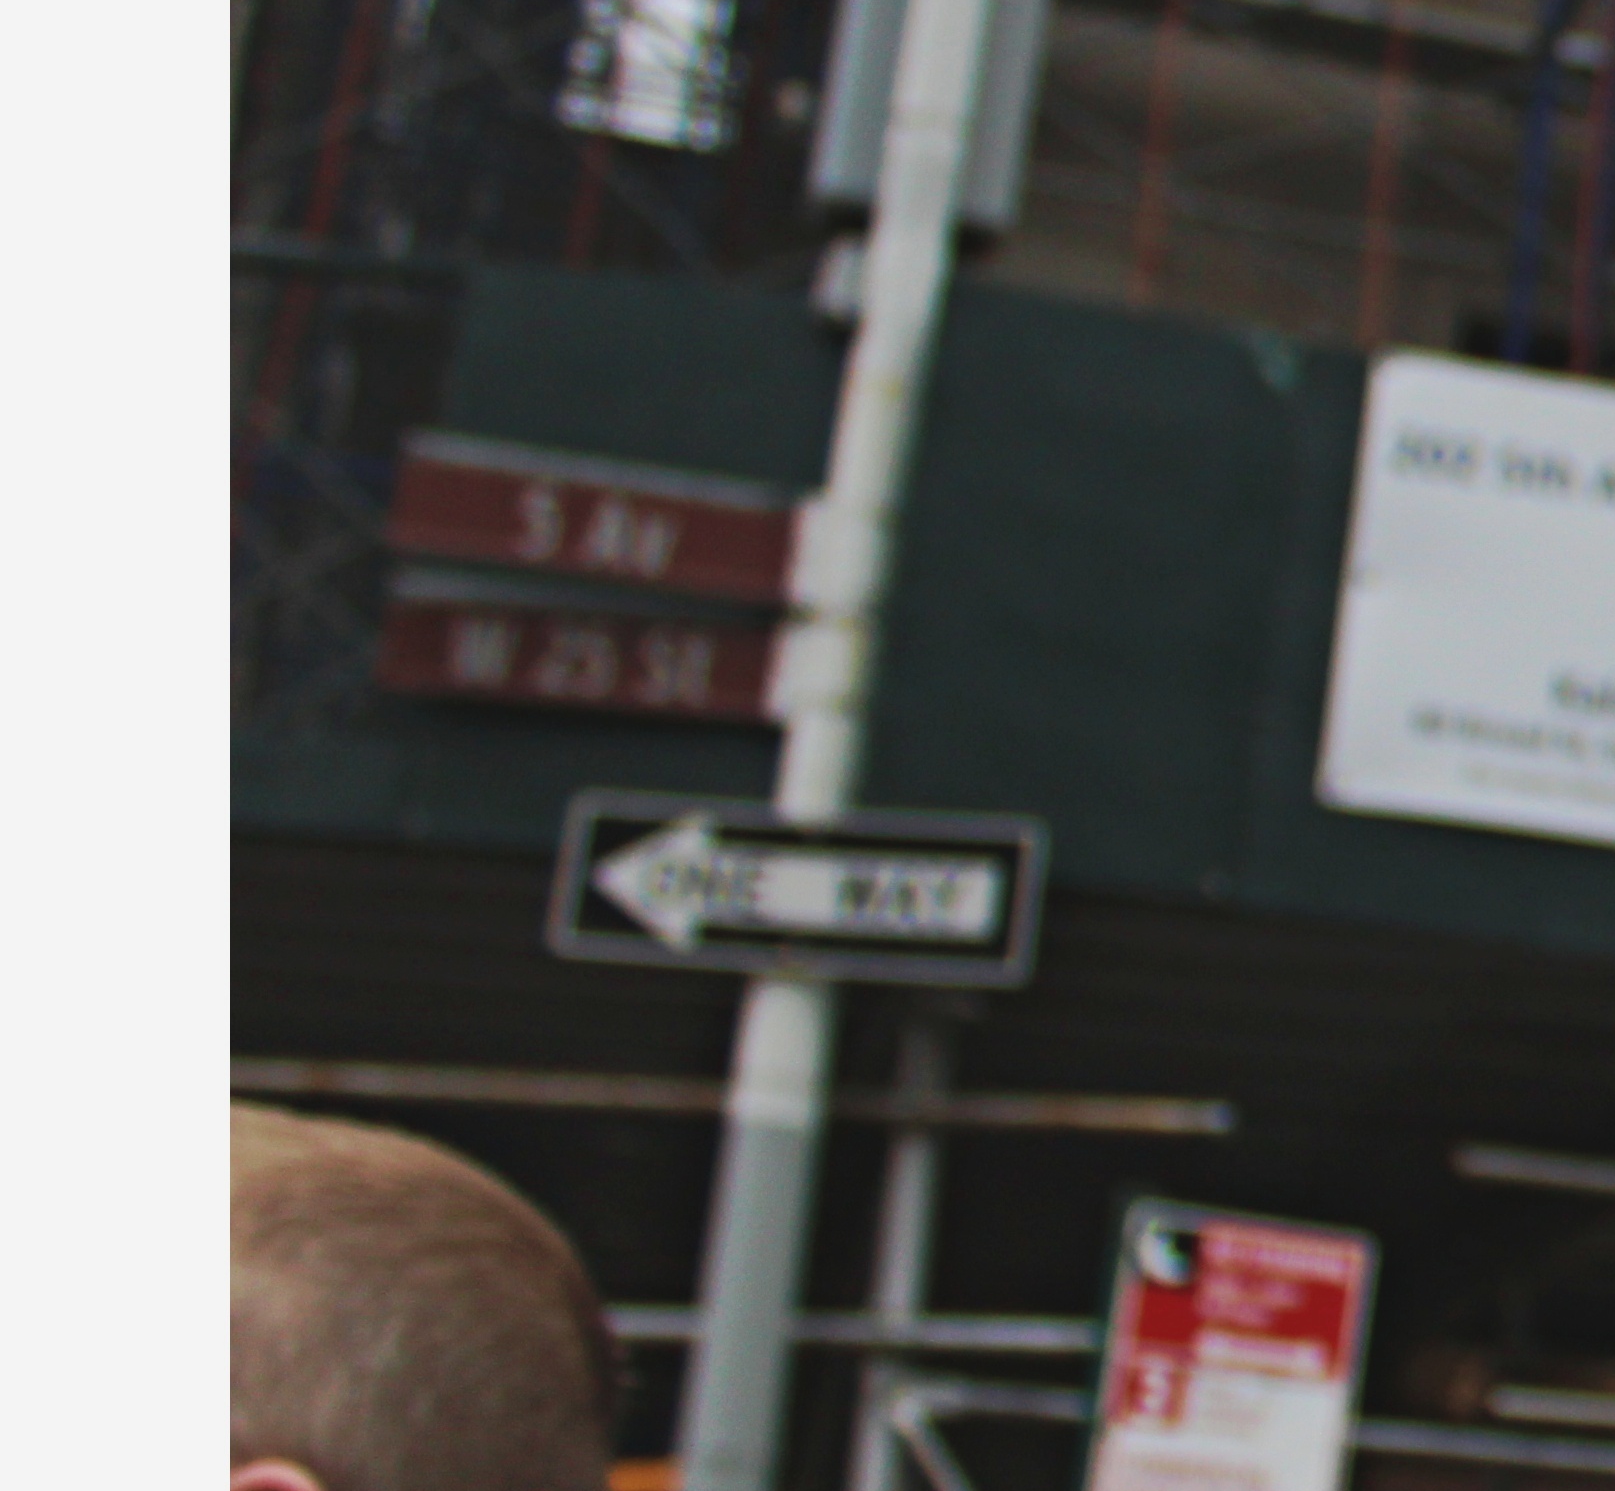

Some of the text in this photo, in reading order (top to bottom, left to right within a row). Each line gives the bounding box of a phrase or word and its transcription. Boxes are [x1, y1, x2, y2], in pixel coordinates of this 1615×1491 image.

[580, 486, 684, 580] Av
[642, 856, 968, 926] ONE WAY
